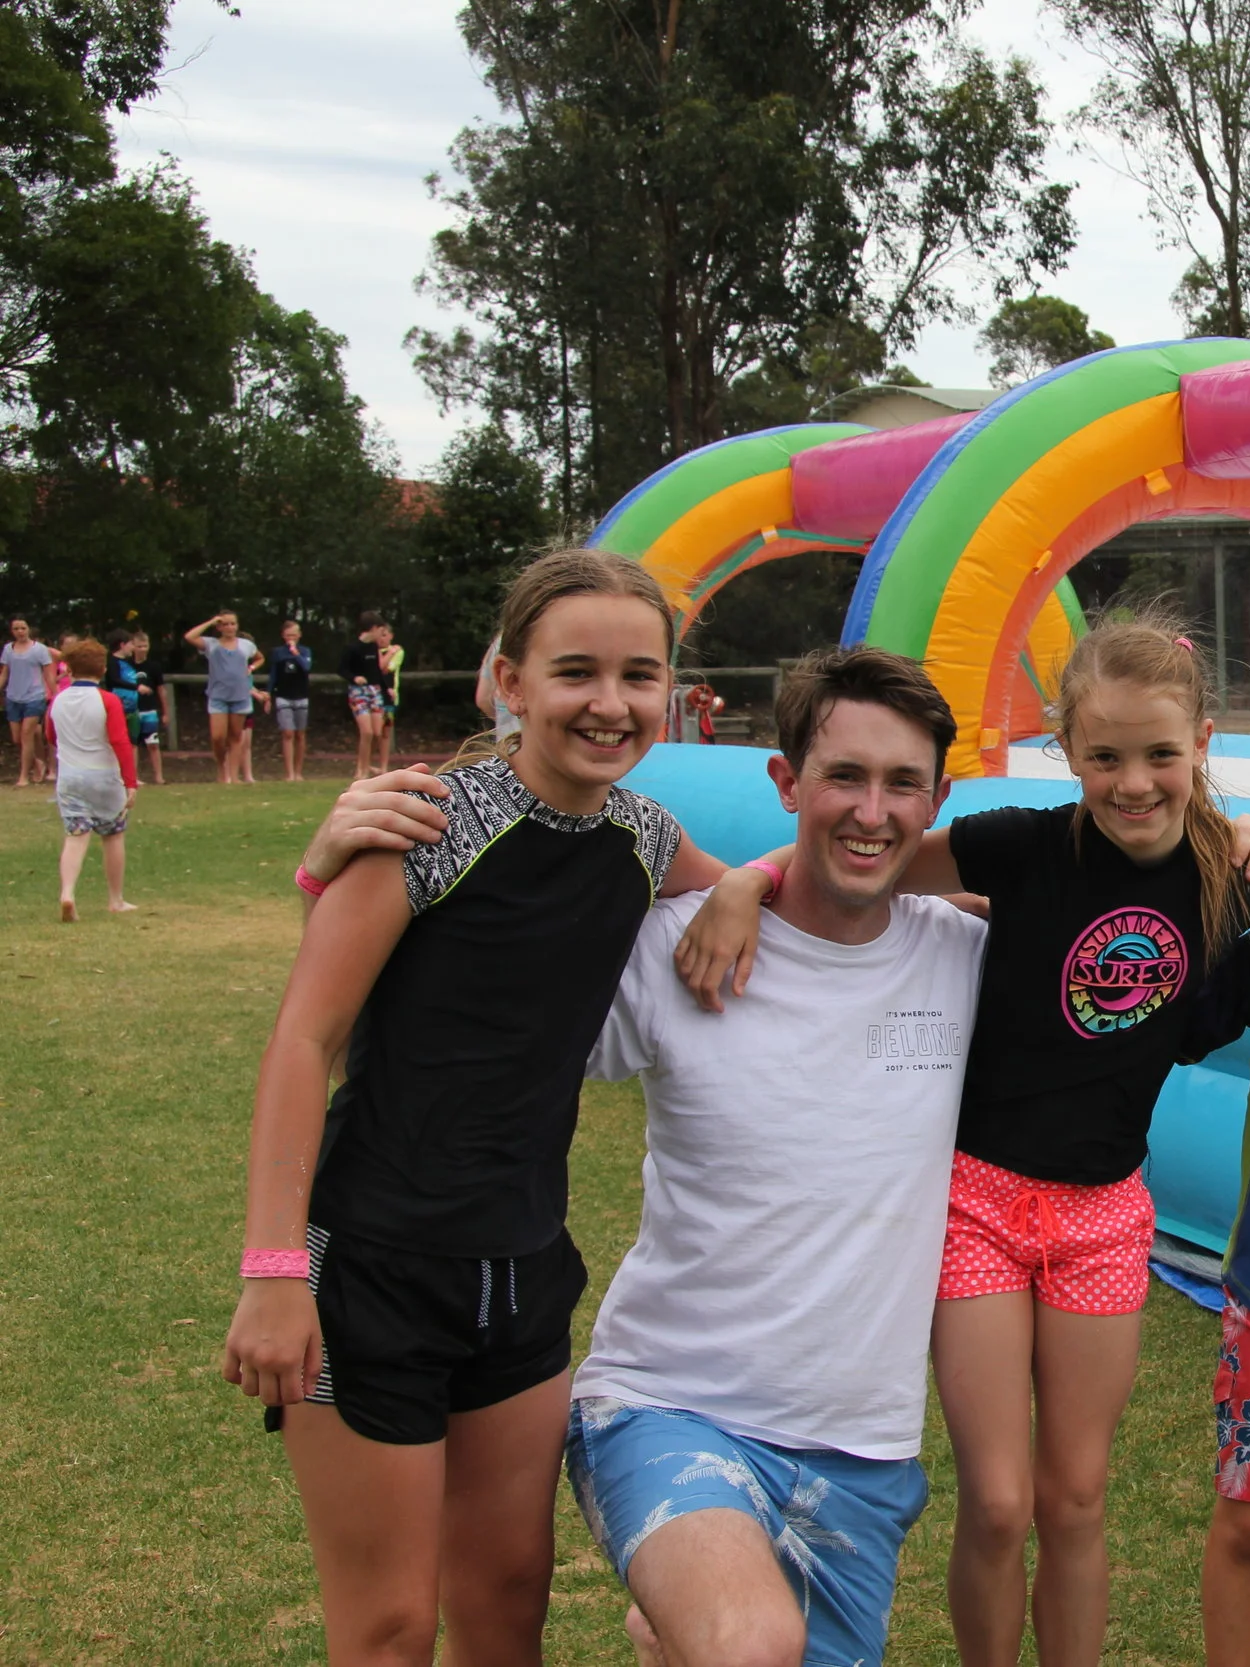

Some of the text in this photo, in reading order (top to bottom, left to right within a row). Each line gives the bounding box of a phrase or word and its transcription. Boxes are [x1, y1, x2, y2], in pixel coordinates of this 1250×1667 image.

[1081, 915, 1180, 957] SUMMER
[1075, 959, 1157, 985] SURF
[866, 1022, 961, 1059] BELONG
